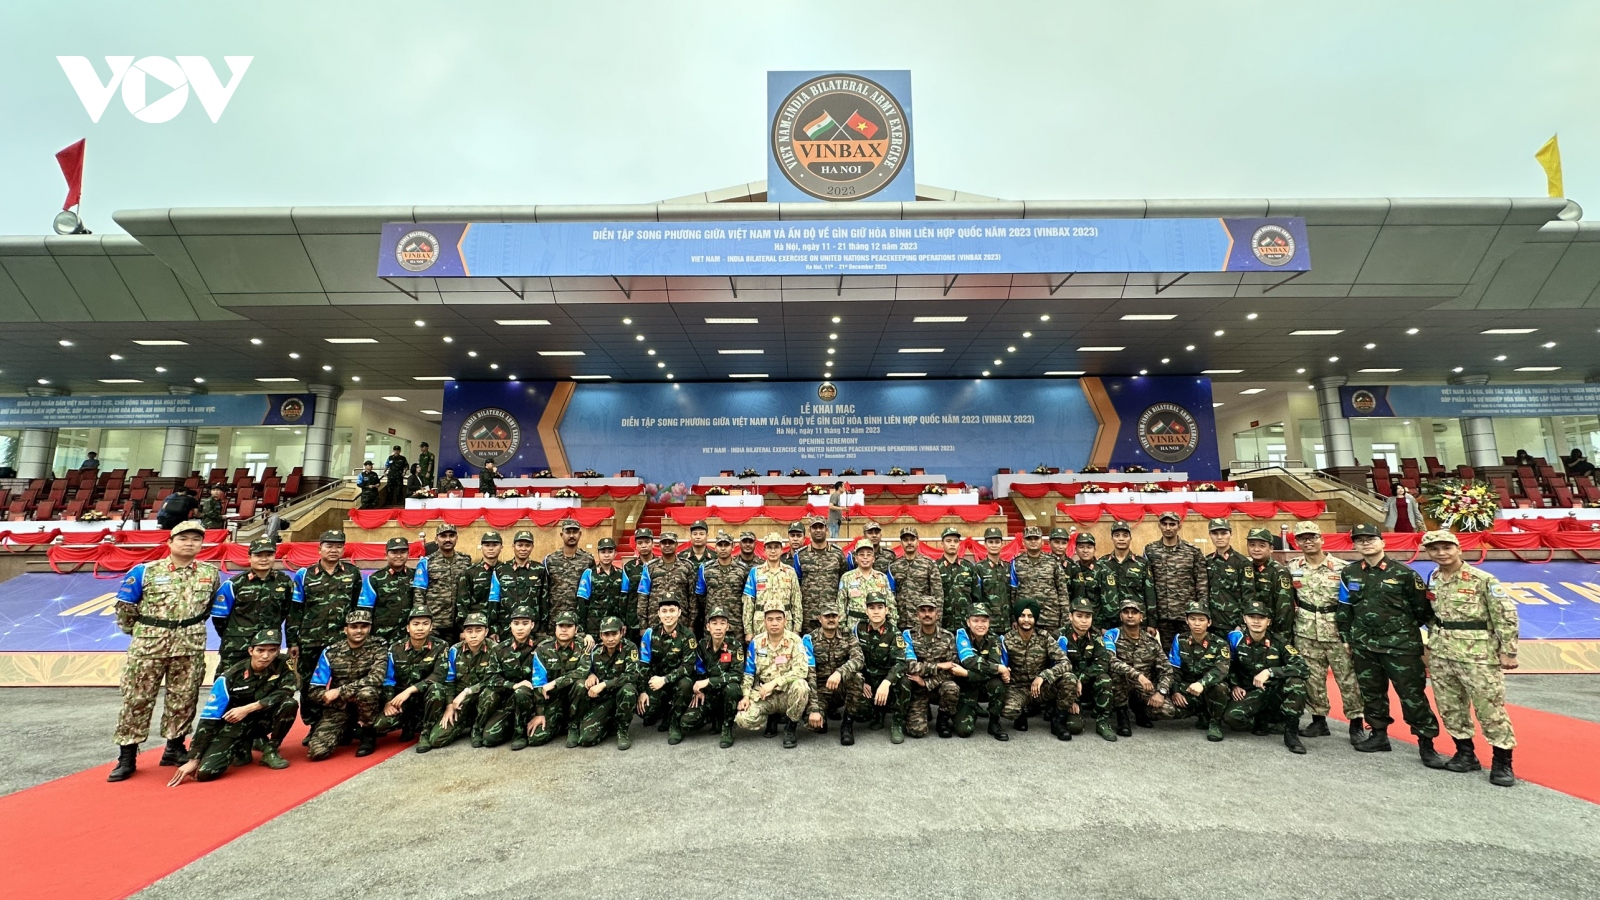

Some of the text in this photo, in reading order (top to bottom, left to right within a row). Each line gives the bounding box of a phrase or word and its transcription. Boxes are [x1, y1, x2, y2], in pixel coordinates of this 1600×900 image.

[780, 146, 798, 170] VIET
[810, 80, 868, 96] BILATERAL
[870, 91, 896, 117] ARMY
[884, 118, 902, 168] EXERCISE
[800, 143, 882, 158] VINBAX
[826, 186, 856, 196] 2023
[593, 227, 614, 240] DIỄN
[617, 230, 634, 242] TẬP
[637, 230, 661, 240] SONG
[664, 229, 701, 239] PHƯƠNG
[704, 228, 725, 239] GIỮA
[728, 228, 747, 241] VIỆT
[750, 229, 771, 239] NAM
[774, 227, 785, 238] VÀ
[788, 226, 800, 238] ẤN
[803, 228, 815, 241] ĐỘ
[818, 226, 829, 238] VỀ
[832, 227, 848, 238] GÌN
[851, 227, 866, 238] GIỮ
[890, 227, 911, 238] BÌNH
[914, 227, 934, 238] LIÊN
[937, 228, 955, 240] HỢP
[958, 225, 982, 238] QUỐC
[985, 226, 1006, 237] NĂM
[1009, 228, 1031, 237] 2023
[1034, 227, 1070, 238] (VINBAX
[1073, 227, 1098, 238] 2023)
[774, 242, 784, 250] Hà
[786, 242, 800, 253] Nội,
[802, 243, 819, 252] ngày
[849, 243, 869, 251] tháng
[801, 402, 855, 415] LỄ KHAI MẠC
[622, 416, 639, 426] DIỄN
[641, 417, 655, 428] TẬP
[680, 417, 710, 426] PHƯƠNG
[713, 416, 730, 426] GIỮA
[732, 416, 748, 427] VIỆT
[769, 416, 779, 425] VÀ
[781, 415, 792, 425] ẤN
[794, 416, 803, 427] ĐỘ
[806, 415, 815, 425] VỀ
[817, 416, 830, 425] GÌN
[832, 416, 845, 425] GIỮ
[864, 415, 882, 425] BÌNH
[884, 415, 900, 424] LIÊN
[903, 415, 917, 426] HỢP
[920, 413, 940, 424] QUỐC
[942, 414, 960, 424] NĂM
[982, 415, 1011, 424] (VINBAX
[1014, 415, 1035, 424] 2023)
